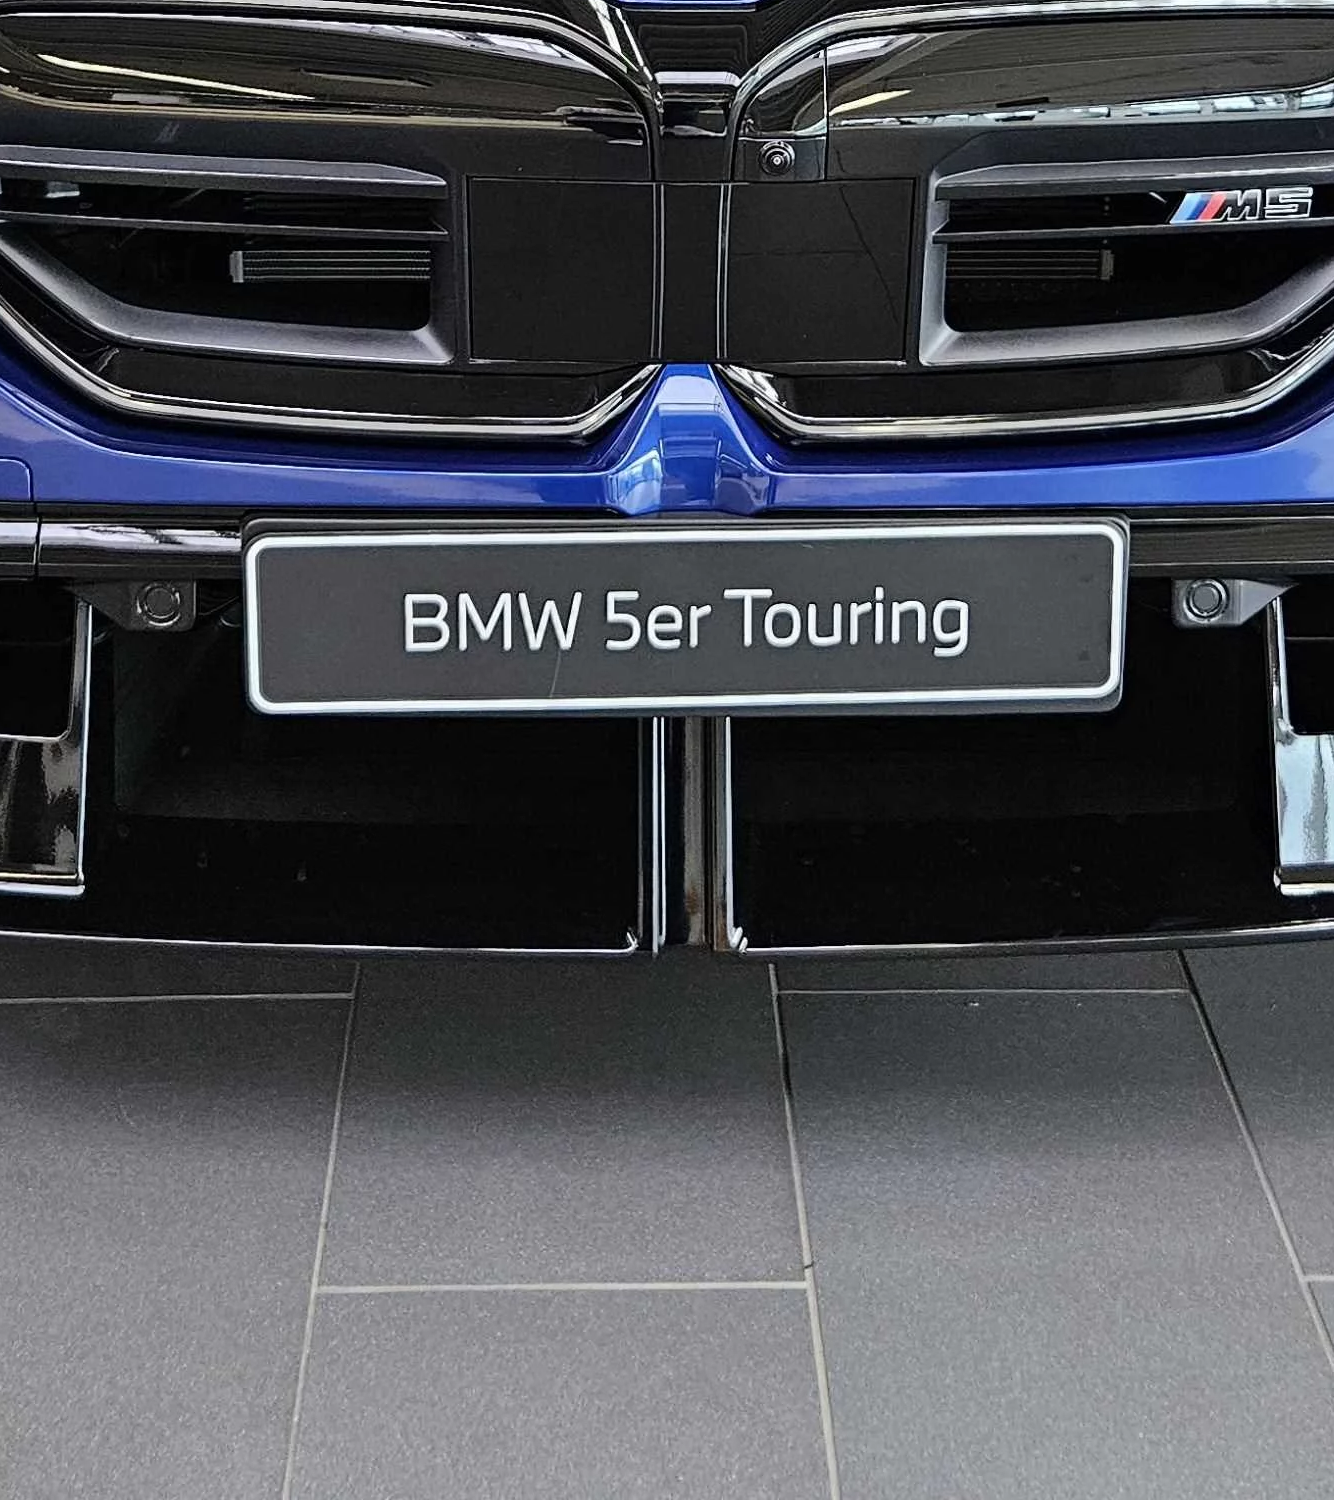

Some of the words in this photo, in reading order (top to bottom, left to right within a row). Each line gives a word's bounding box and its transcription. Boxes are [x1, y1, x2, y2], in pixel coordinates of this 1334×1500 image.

[1212, 186, 1314, 222] M5
[403, 590, 582, 654] BMW
[605, 590, 710, 653] 5er
[723, 586, 970, 658] Touring
